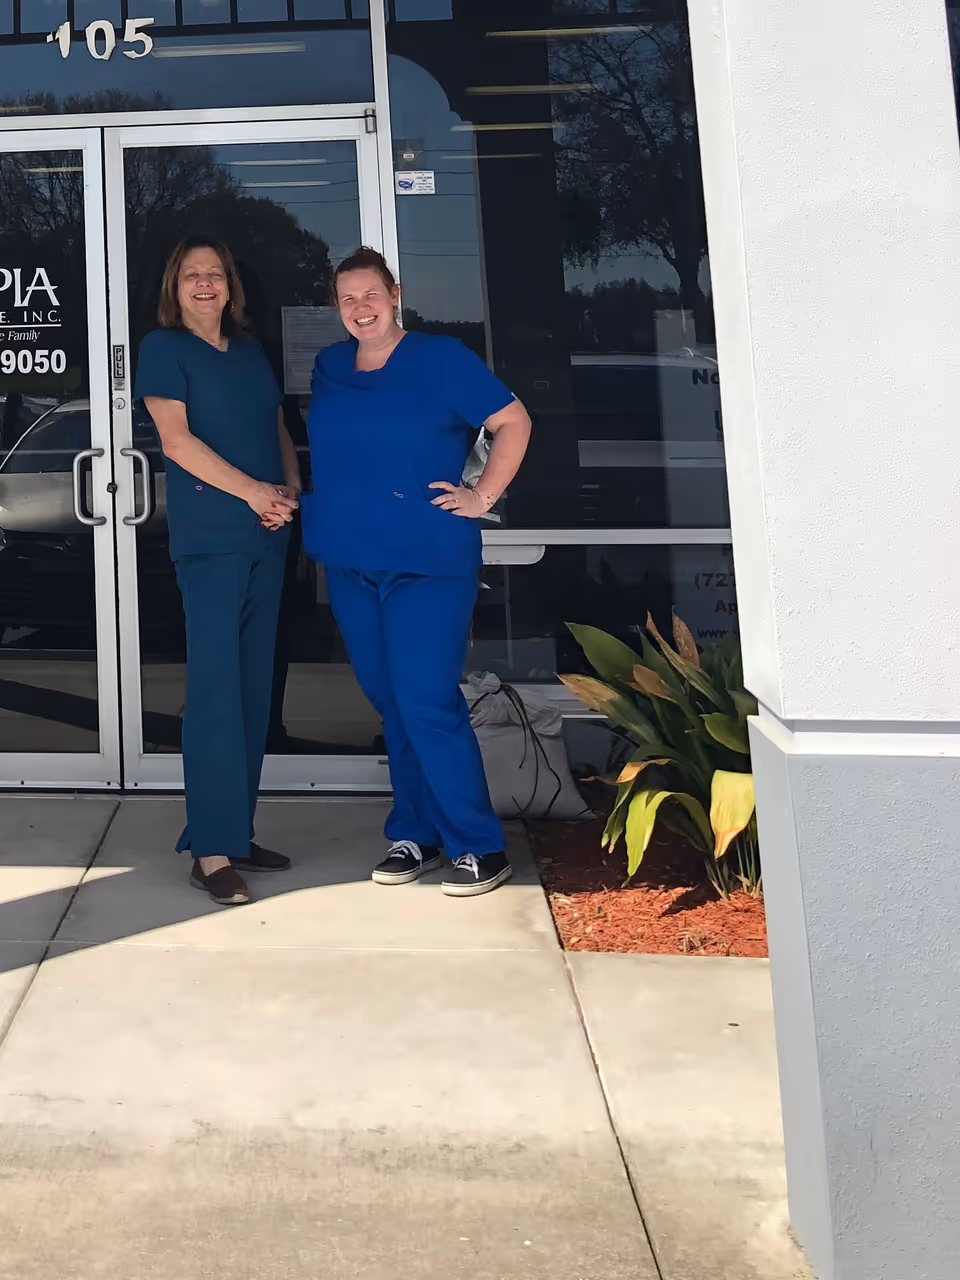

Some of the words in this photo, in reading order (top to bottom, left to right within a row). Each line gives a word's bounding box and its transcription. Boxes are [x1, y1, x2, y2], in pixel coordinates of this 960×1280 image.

[45, 16, 156, 61] 105
[23, 309, 62, 323] INC.
[7, 328, 41, 343] Family
[114, 347, 123, 376] PULL
[694, 572, 736, 591] (72
